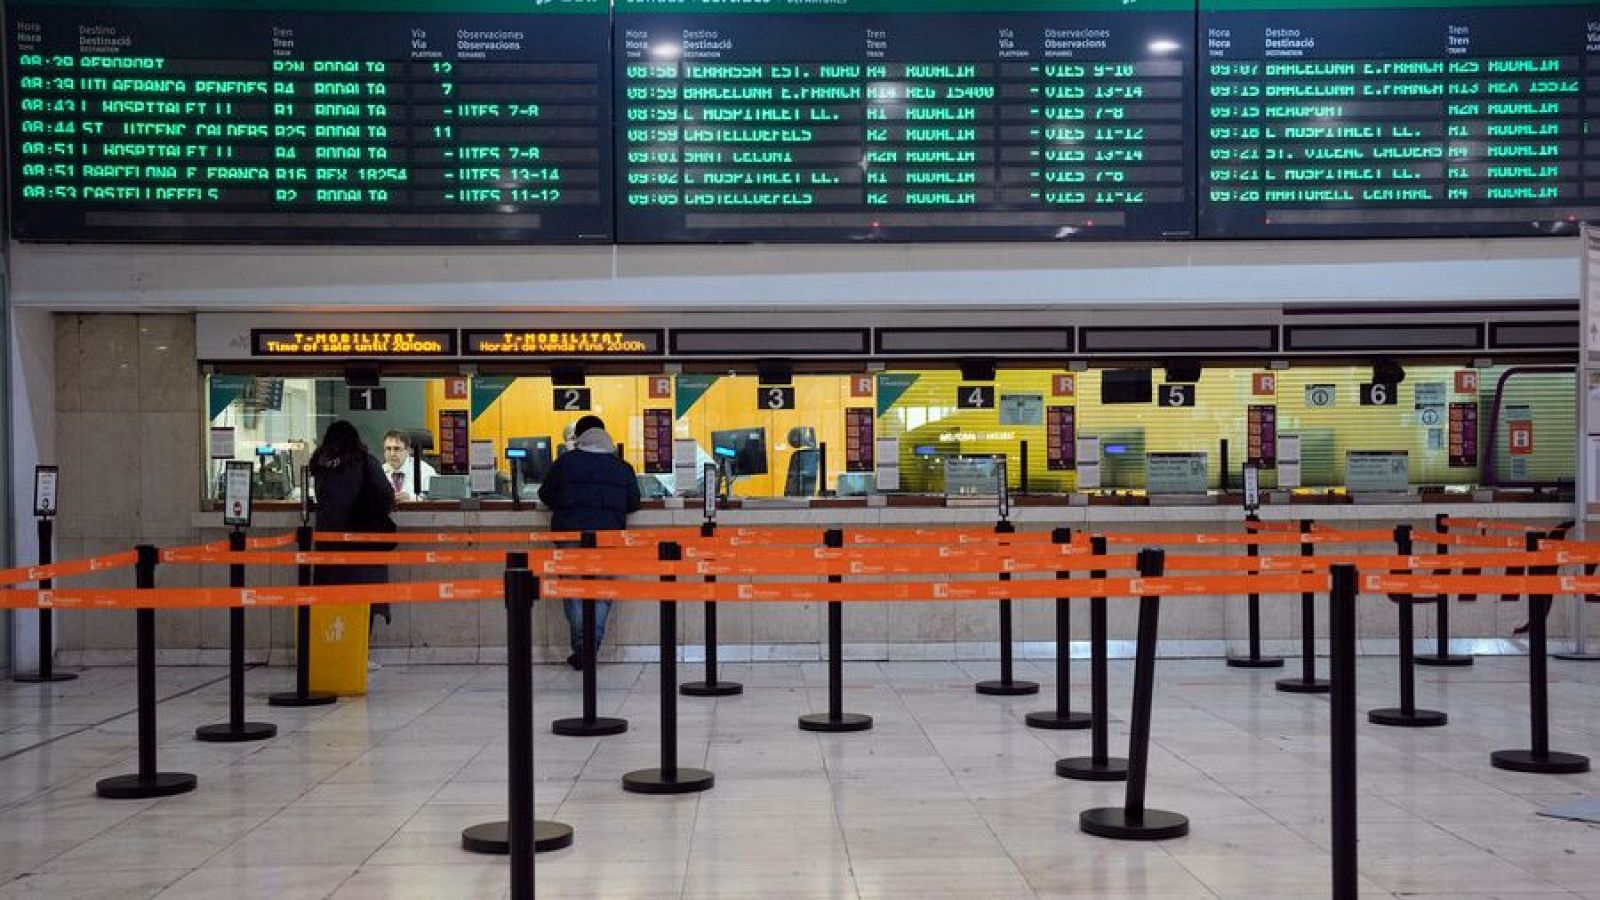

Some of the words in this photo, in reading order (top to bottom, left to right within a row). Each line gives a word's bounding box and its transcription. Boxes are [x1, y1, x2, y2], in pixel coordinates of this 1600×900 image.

[456, 29, 525, 40] Observaciones
[682, 29, 719, 39] Destino
[866, 29, 887, 39] Tren
[1044, 28, 1111, 39] Observaciones
[1208, 28, 1231, 38] Hora
[1265, 27, 1301, 38] Destino
[456, 40, 521, 50] Observacions
[682, 39, 734, 49] Destinació
[866, 40, 888, 49] Tren
[1044, 38, 1107, 49] Observacions
[1208, 38, 1231, 48] Hora
[1265, 37, 1315, 48] Destinació
[1448, 35, 1470, 46] Tren
[1044, 64, 1086, 78] VIES
[273, 81, 296, 95] R4
[441, 82, 453, 96] 7
[1044, 85, 1086, 99] VIES
[273, 103, 294, 116] R1
[1044, 107, 1086, 120] VIES
[21, 120, 76, 134] 08:44
[433, 125, 451, 138] 11
[1044, 128, 1086, 141] VIES
[21, 142, 76, 155] 08:51
[273, 146, 297, 159] R4
[1044, 149, 1086, 162] VIES
[21, 163, 76, 176] 08:51
[1044, 171, 1086, 183] VIES
[1044, 191, 1086, 204] VIES
[295, 332, 415, 343] T-MOBILITAT
[504, 332, 624, 343] T-MOBILITAT
[266, 341, 298, 352] Time
[303, 342, 318, 352] of
[322, 341, 351, 352] sale
[355, 340, 388, 352] until
[479, 341, 519, 352] Horari
[522, 341, 536, 352] de
[539, 341, 575, 352] venda
[578, 340, 603, 352] fins
[859, 378, 871, 392] R
[1060, 378, 1074, 391] R
[361, 388, 372, 410] 1
[564, 389, 581, 410] 2
[768, 388, 785, 409] 3
[968, 387, 984, 408] 4
[1169, 385, 1185, 406] 5
[1371, 384, 1386, 404] 6
